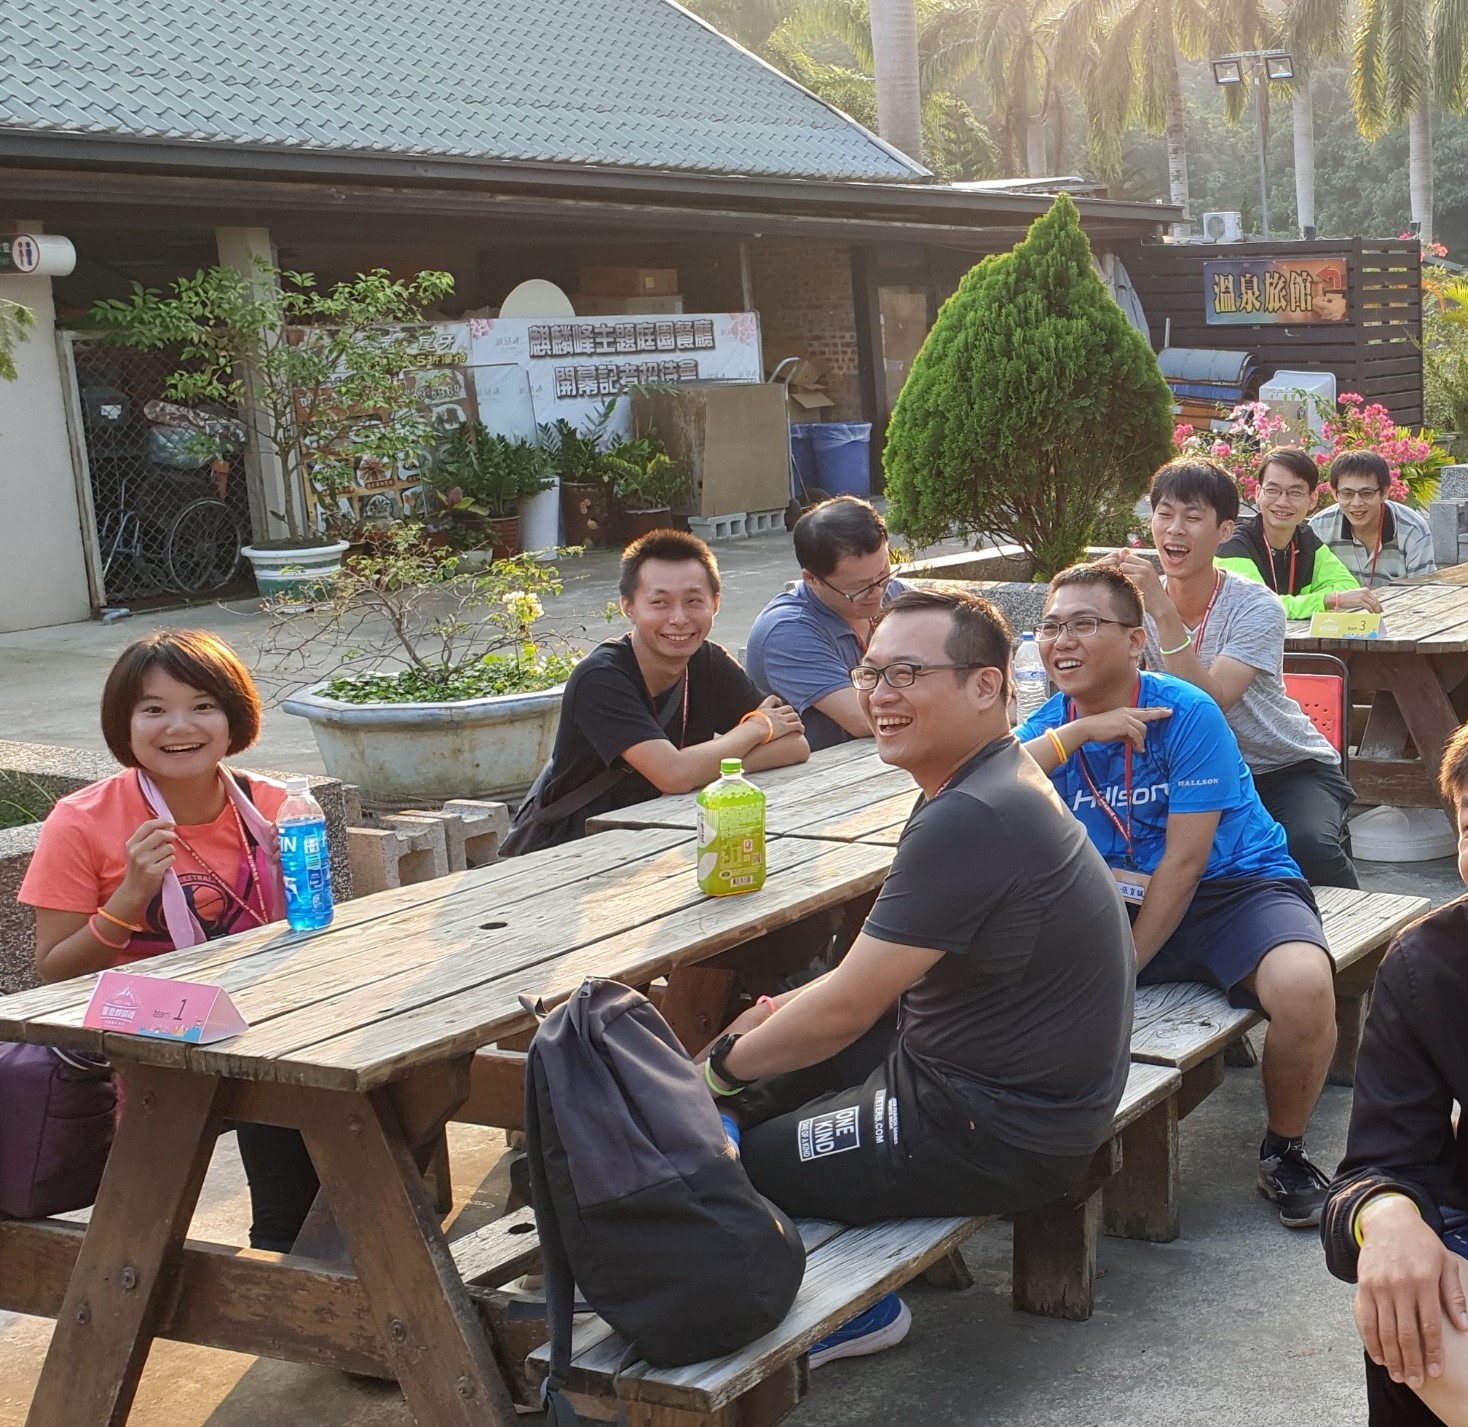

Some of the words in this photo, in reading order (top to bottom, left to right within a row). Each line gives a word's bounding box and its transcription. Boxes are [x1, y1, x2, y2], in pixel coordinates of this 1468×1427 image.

[1213, 271, 1313, 313] 溫泉旅館
[527, 319, 716, 358] 麒麟峰主題庭園餐廳
[1359, 620, 1366, 631] 3
[1177, 778, 1219, 787] HALLSON
[1073, 783, 1170, 812] Hllson
[173, 998, 187, 1021] 1
[815, 1120, 835, 1153] KIND
[835, 1110, 855, 1137] ONE
